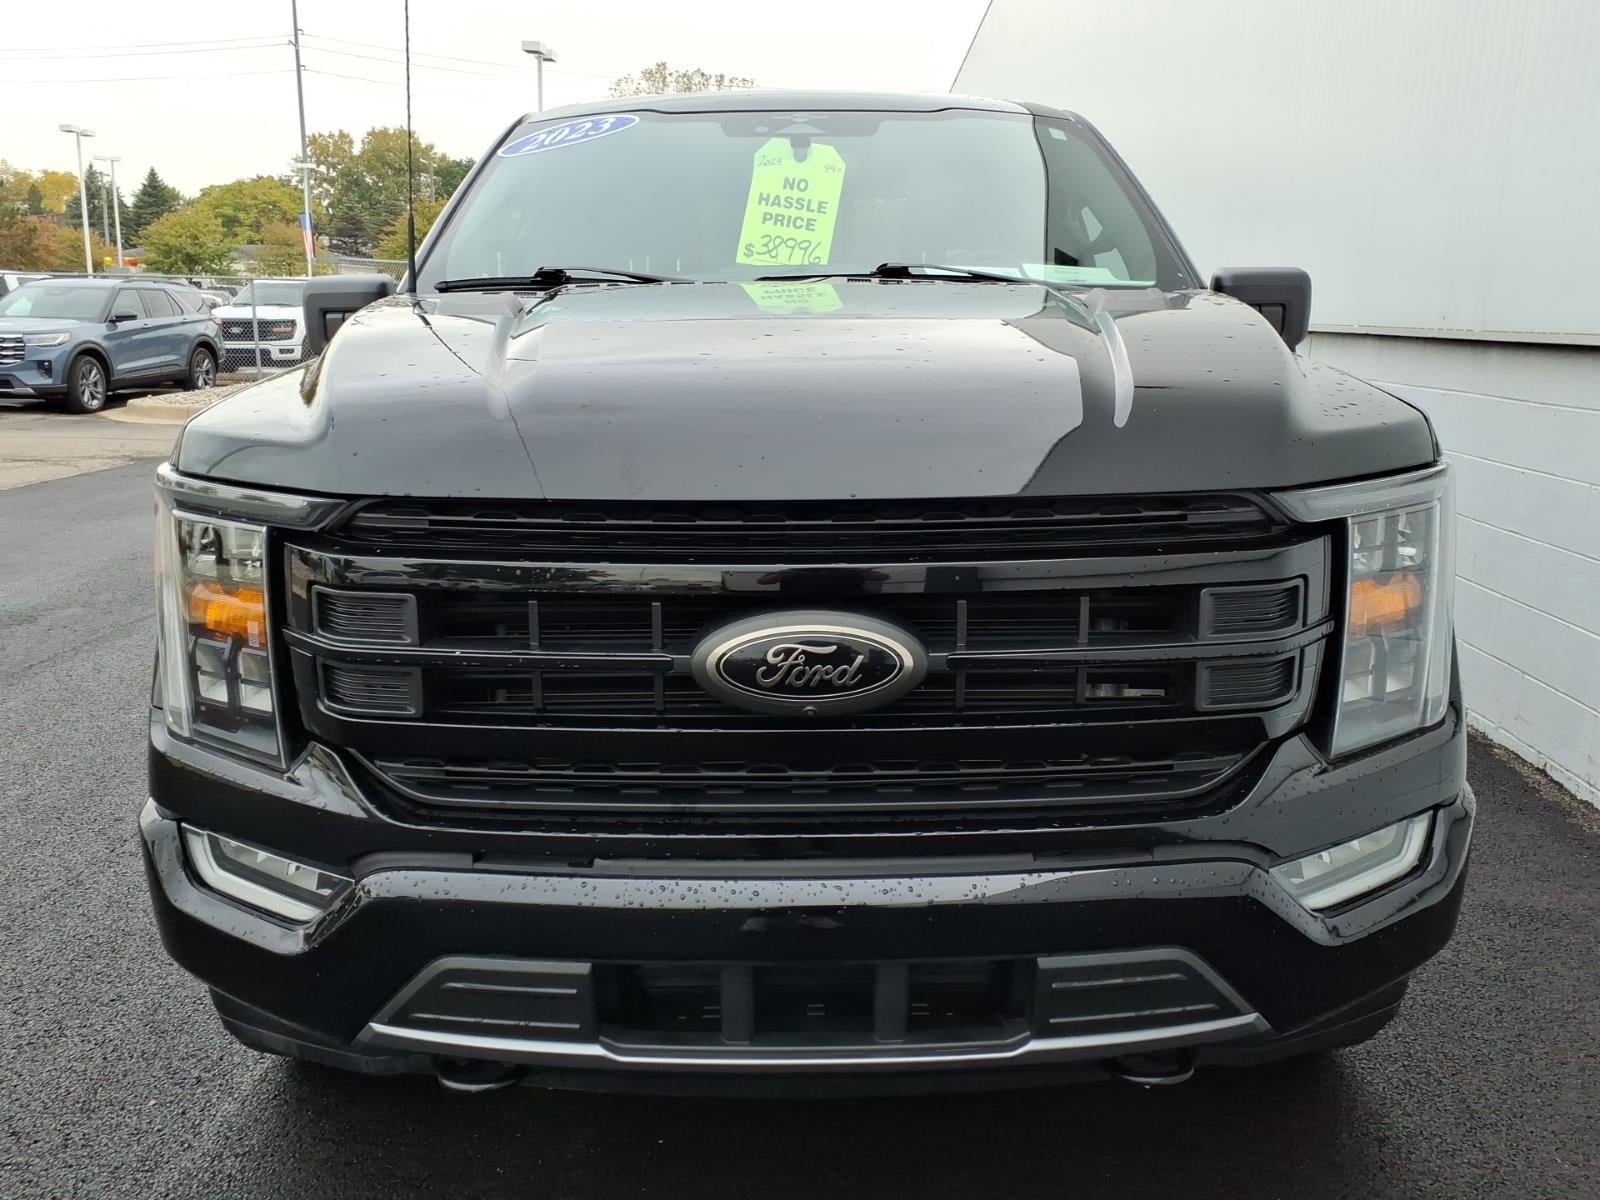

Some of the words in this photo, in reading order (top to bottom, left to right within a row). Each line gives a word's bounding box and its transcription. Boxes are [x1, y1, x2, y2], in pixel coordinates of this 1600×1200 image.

[519, 117, 617, 153] 2023
[782, 176, 809, 193] NO
[757, 192, 829, 214] HASSLE
[761, 212, 817, 232] PRICE
[755, 643, 865, 689] Ford
